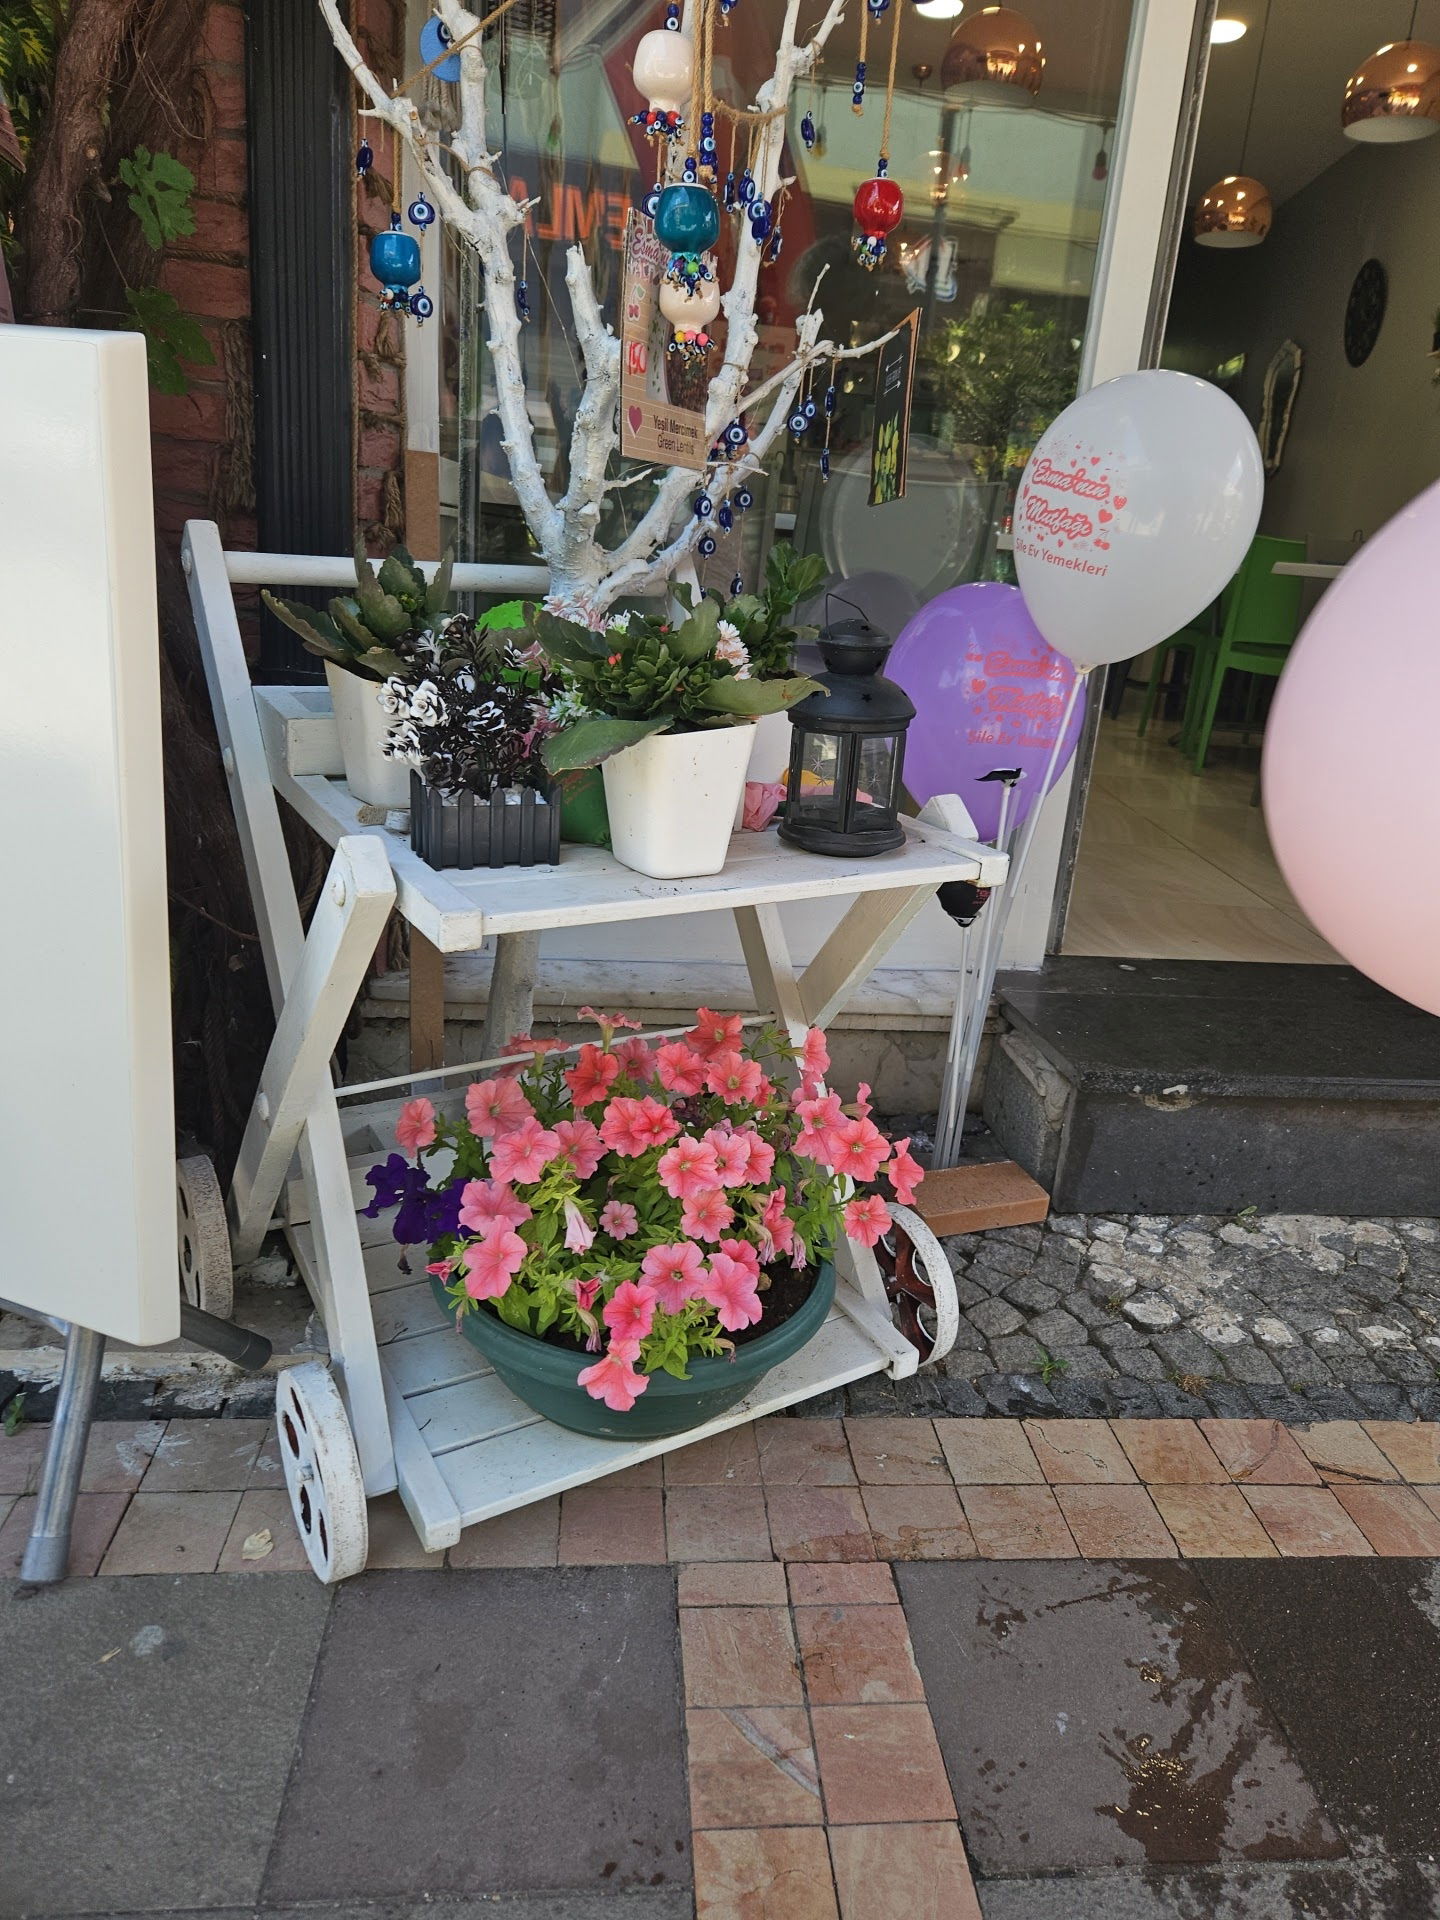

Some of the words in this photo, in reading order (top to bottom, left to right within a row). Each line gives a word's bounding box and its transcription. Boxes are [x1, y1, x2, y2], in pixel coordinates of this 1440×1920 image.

[669, 419, 698, 439] Mercimek
[657, 434, 676, 451] Green
[1027, 544, 1039, 558] Ev
[1041, 548, 1109, 577] Yemekleri
